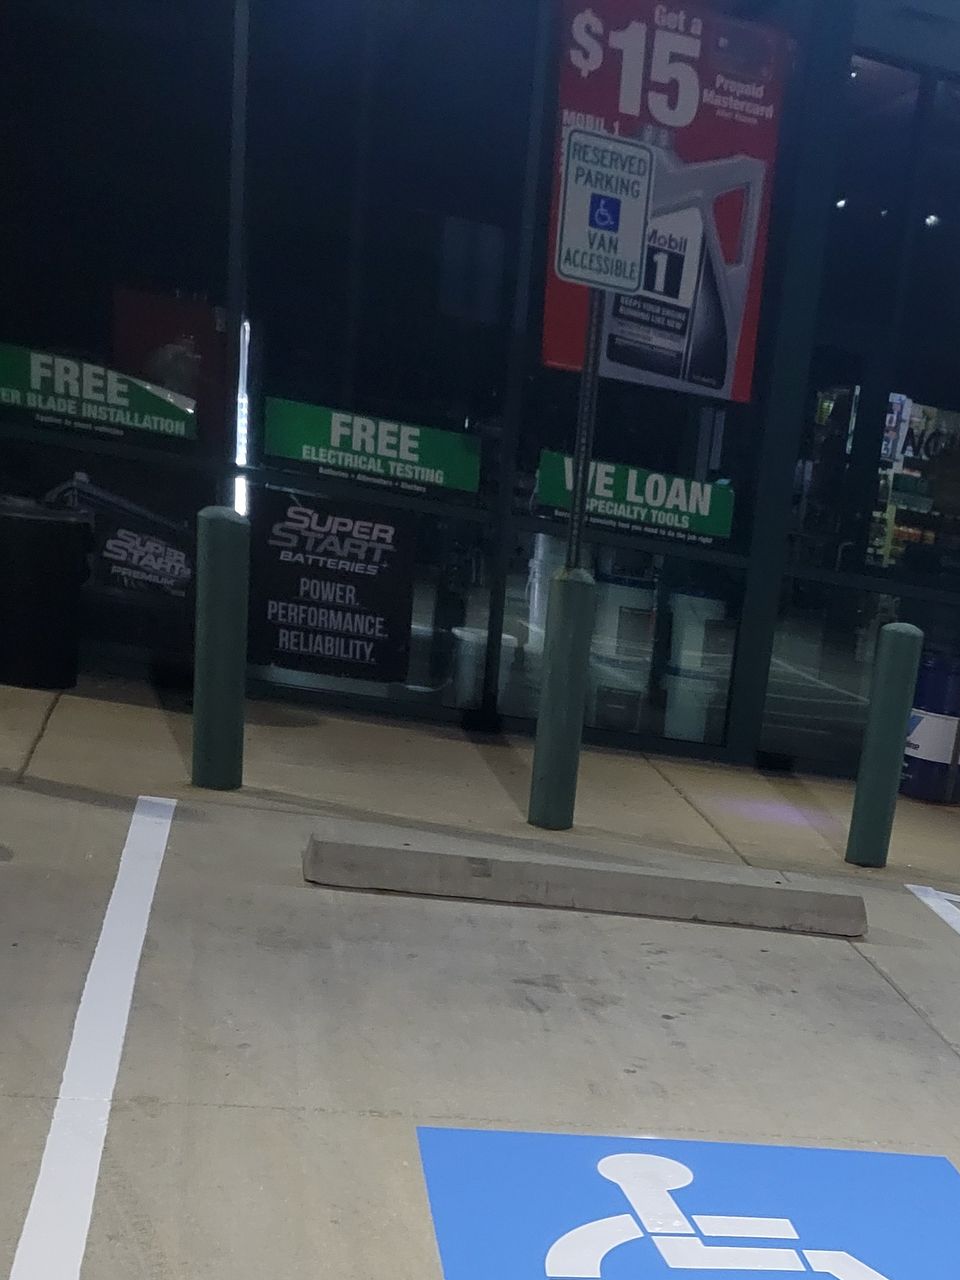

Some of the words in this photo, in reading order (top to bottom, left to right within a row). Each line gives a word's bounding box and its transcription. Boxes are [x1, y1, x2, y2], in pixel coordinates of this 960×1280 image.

[569, 8, 701, 128] $15
[572, 142, 647, 177] RESERVED
[575, 166, 640, 198] PARKING
[588, 231, 619, 254] VAN
[648, 229, 688, 252] Mobil
[564, 247, 637, 281] ACCESSIBLE
[653, 252, 668, 293] 1
[30, 351, 130, 407] FREE
[27, 391, 77, 415] BLADE
[82, 402, 186, 435] INSTALLATION
[330, 411, 420, 463] FREE
[302, 445, 385, 474] ELECTRICAL
[389, 461, 444, 485] TESTING
[626, 468, 713, 516] LOAN
[286, 506, 396, 544] SUPER
[651, 509, 690, 529] TOOLS
[103, 538, 187, 578] START
[116, 528, 187, 565] SUPER
[268, 522, 397, 562] START
[280, 550, 378, 576] BATTERIES
[300, 577, 360, 606] POWER.
[267, 600, 389, 638] PERFORMANCE.
[278, 628, 376, 662] RELIABILITY.
